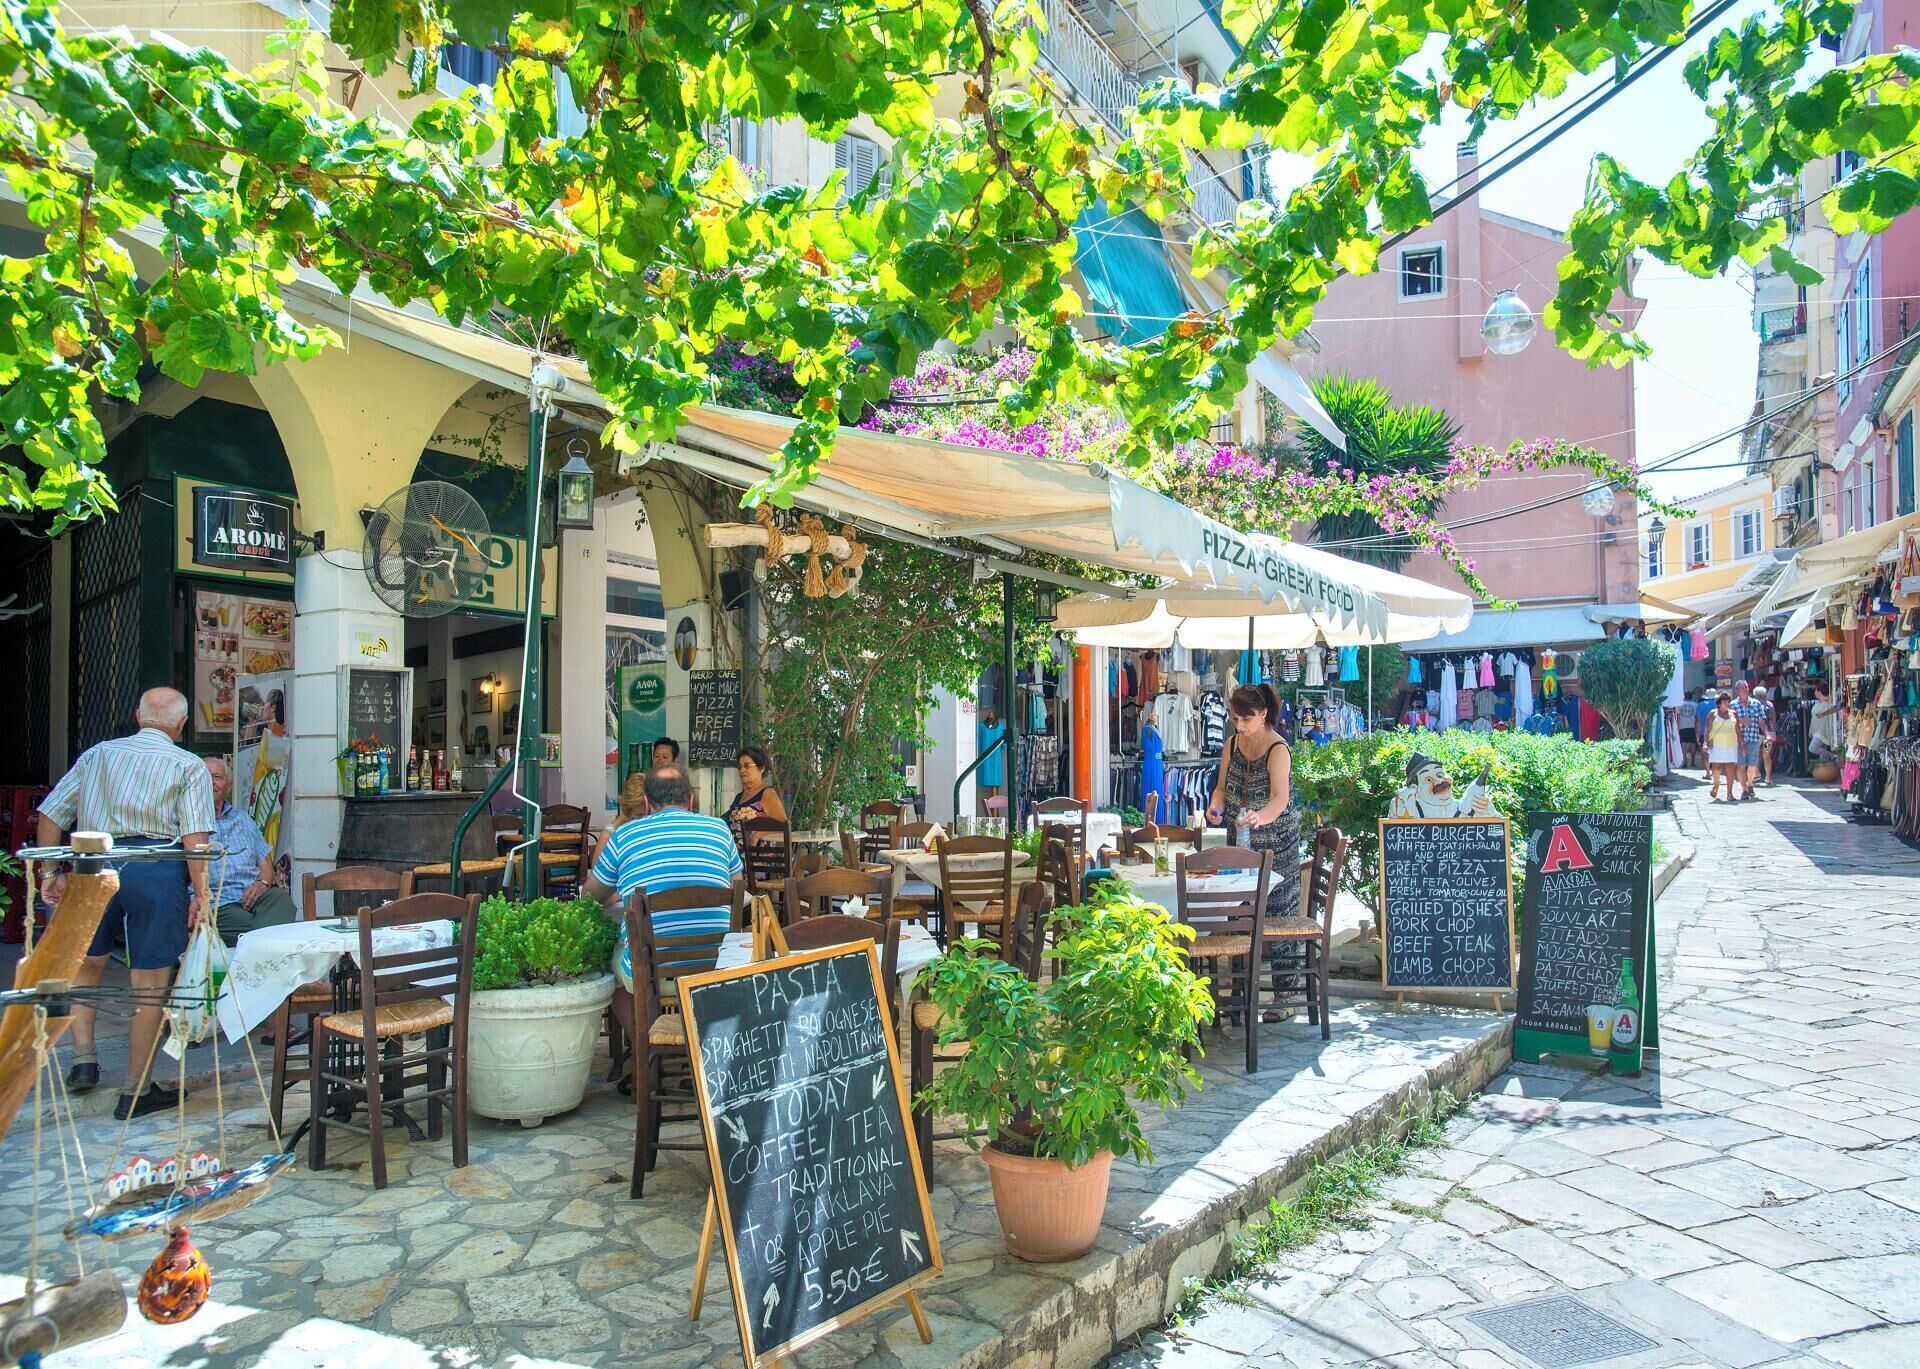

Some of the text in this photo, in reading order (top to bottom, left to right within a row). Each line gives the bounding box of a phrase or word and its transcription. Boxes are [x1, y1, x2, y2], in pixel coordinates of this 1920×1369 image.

[213, 527, 285, 551] AROMÈ
[1319, 580, 1354, 611] FOOD
[718, 670, 736, 679] CAFE
[690, 681, 740, 694] HOME MADE
[697, 696, 734, 710] PIZZA
[695, 715, 734, 729] FREE
[690, 748, 718, 759] GREEK
[1551, 816, 1569, 825] 1961
[1577, 813, 1649, 828] TRADITIONAL
[1387, 826, 1486, 841] GREEK BURGER
[1387, 841, 1413, 851] WITH
[1386, 862, 1486, 876] GREEK PIZZA
[1600, 860, 1642, 875] SNACK
[1389, 877, 1417, 886] WITH
[1389, 886, 1422, 896] FRESH
[1496, 888, 1508, 897] OIL
[1546, 888, 1633, 906] PITA GYROS
[1390, 901, 1504, 917] GRILLED DISHES
[1392, 916, 1475, 933] PORK CHOP
[1539, 909, 1617, 928] SOUVLAKI
[1393, 933, 1496, 954] BEEF STEAK
[1394, 956, 1496, 975] LAMB CHOPS
[752, 958, 842, 1015] PASTA
[1534, 979, 1587, 995] STUFFED
[701, 998, 879, 1066] SPAGHETTI BOLOGNESE
[707, 1024, 886, 1101] SPAGHETTI NAPOLITANA
[768, 1072, 851, 1131] TODAY
[845, 1104, 893, 1146] TEA
[771, 1144, 903, 1202] TRADITIONAL
[793, 1172, 896, 1234] BAKLAVA
[764, 1203, 894, 1271] OR APPLE PIE
[803, 1246, 889, 1310] 5.50€
